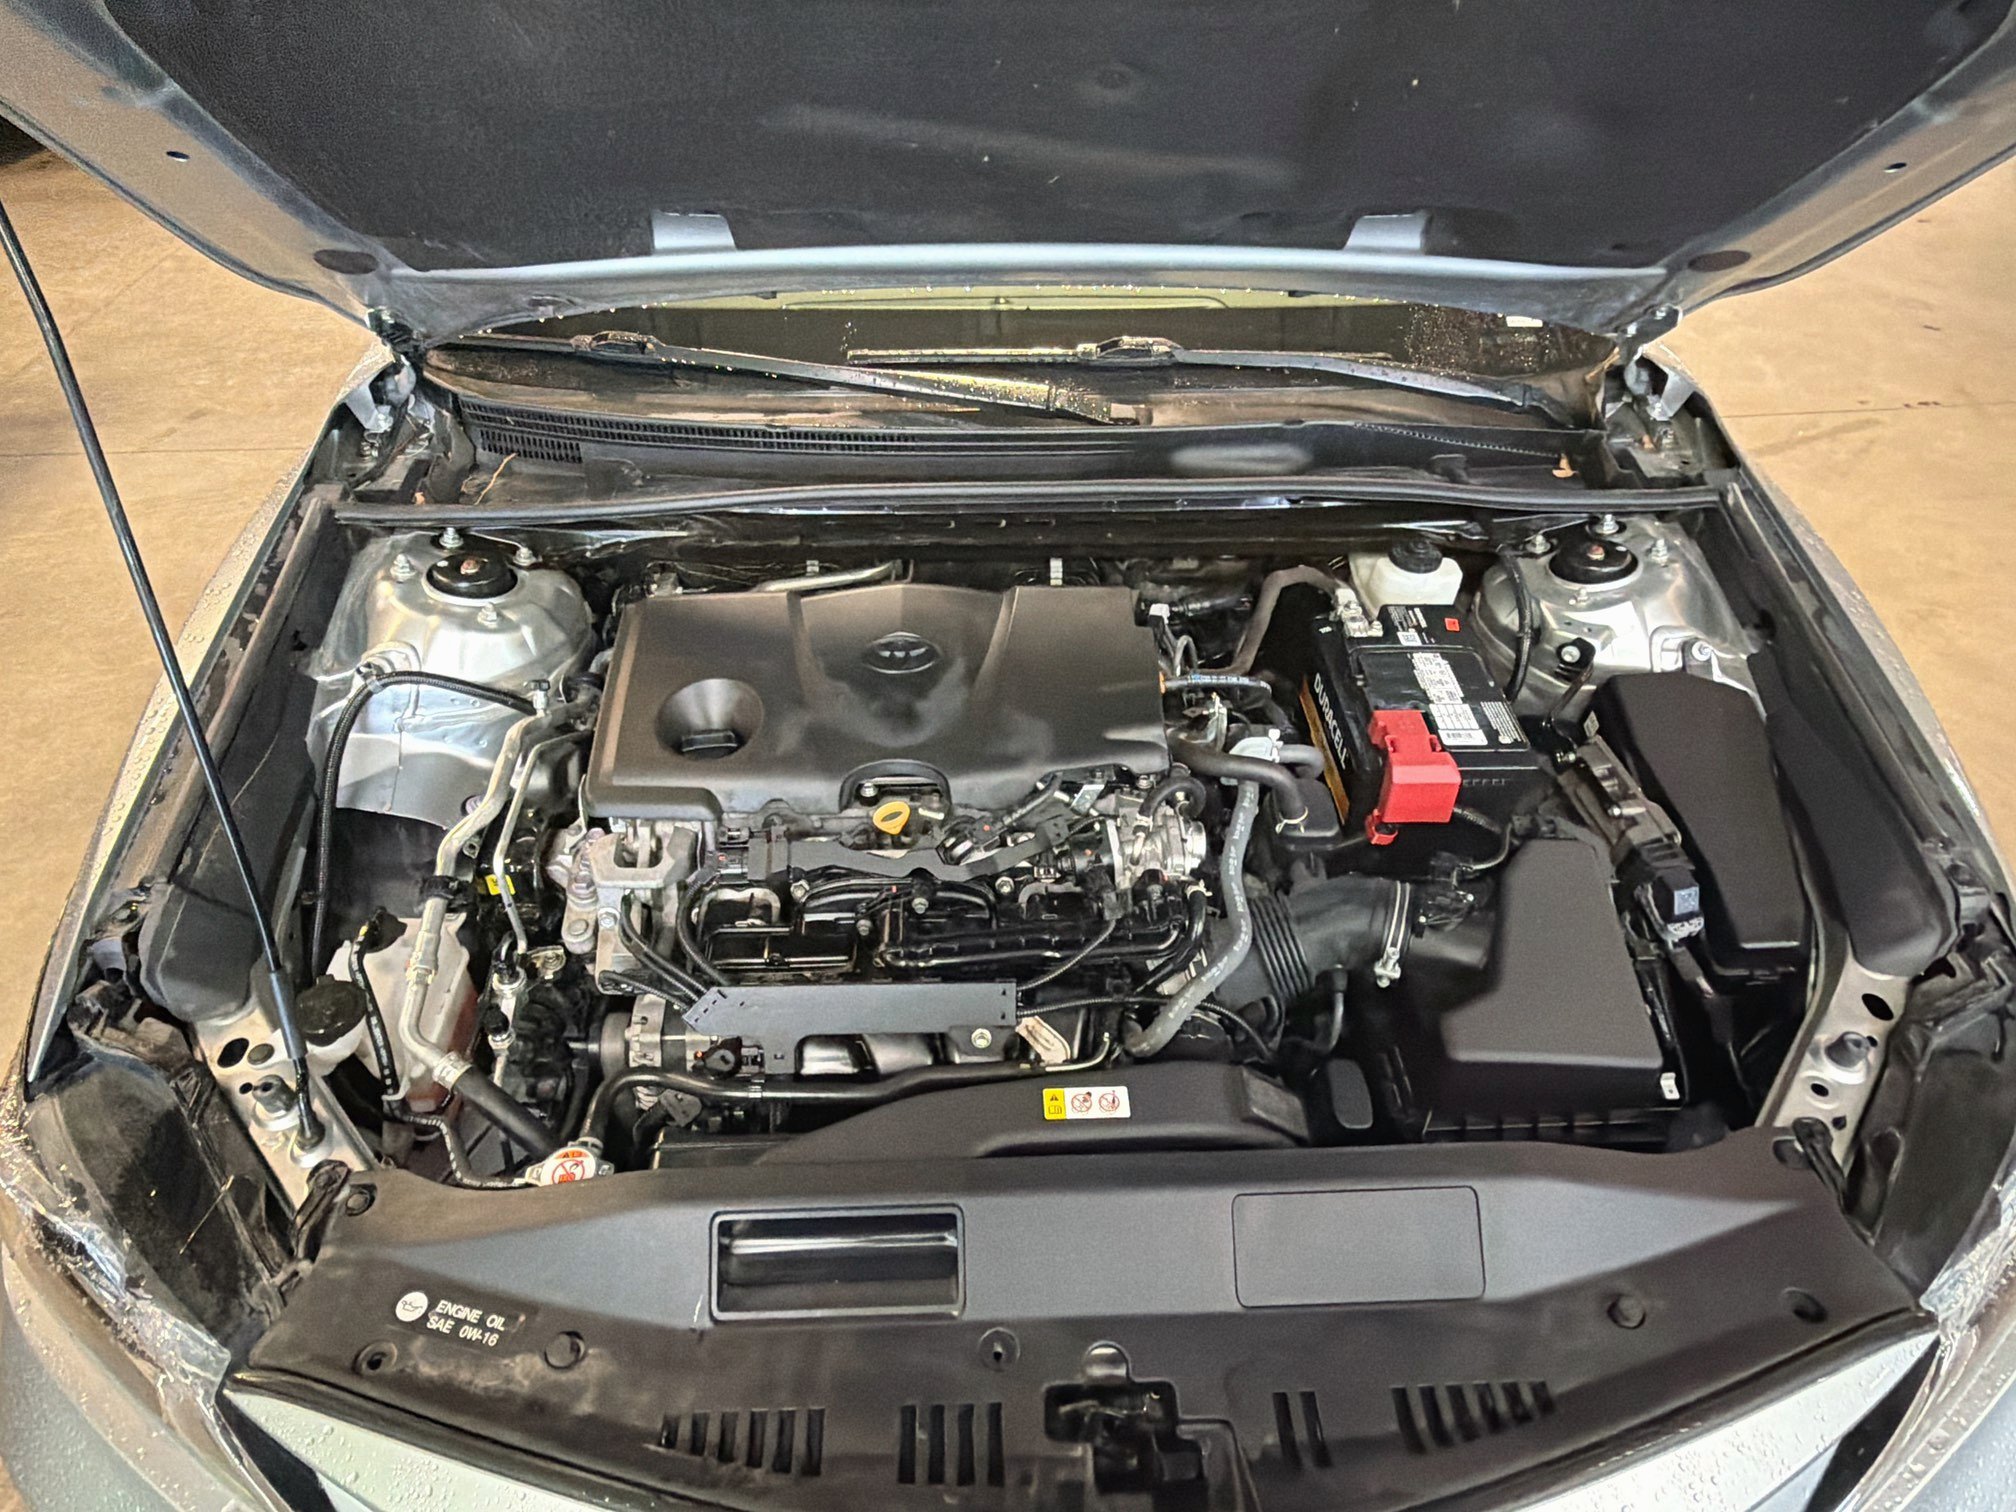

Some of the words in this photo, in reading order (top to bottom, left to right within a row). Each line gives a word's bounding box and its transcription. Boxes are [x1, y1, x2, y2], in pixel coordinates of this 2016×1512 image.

[1313, 672, 1348, 770] DURACELL
[426, 1315, 456, 1334] SAE
[458, 1325, 500, 1347] 0W-16
[435, 1299, 483, 1324] ENGINE
[486, 1314, 506, 1332] OIL
